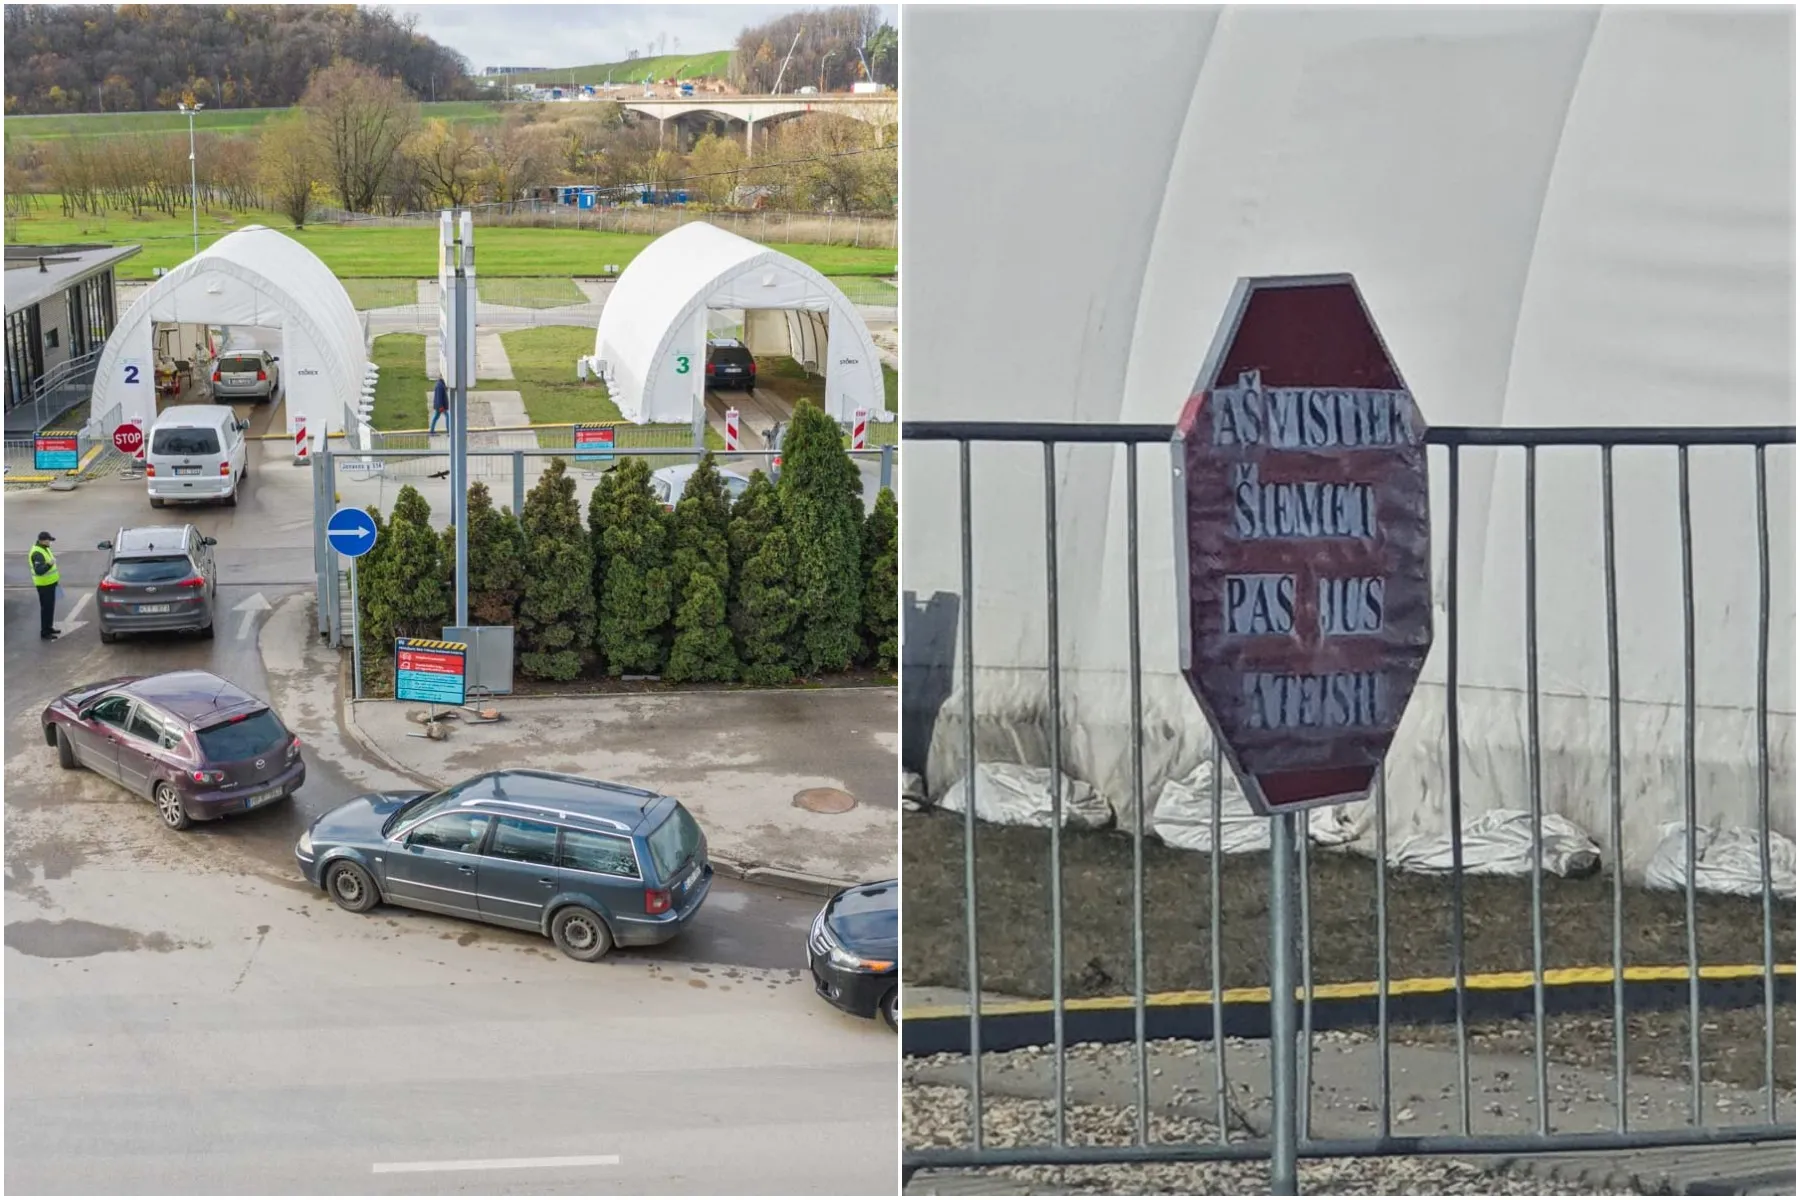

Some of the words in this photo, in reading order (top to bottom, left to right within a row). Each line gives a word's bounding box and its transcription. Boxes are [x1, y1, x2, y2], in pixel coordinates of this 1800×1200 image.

[676, 356, 690, 374] 3
[124, 366, 139, 383] 2
[115, 432, 141, 445] STOP
[1236, 464, 1375, 537] ŠIEMET
[1227, 576, 1295, 634] PAS
[1321, 577, 1383, 632] JUS
